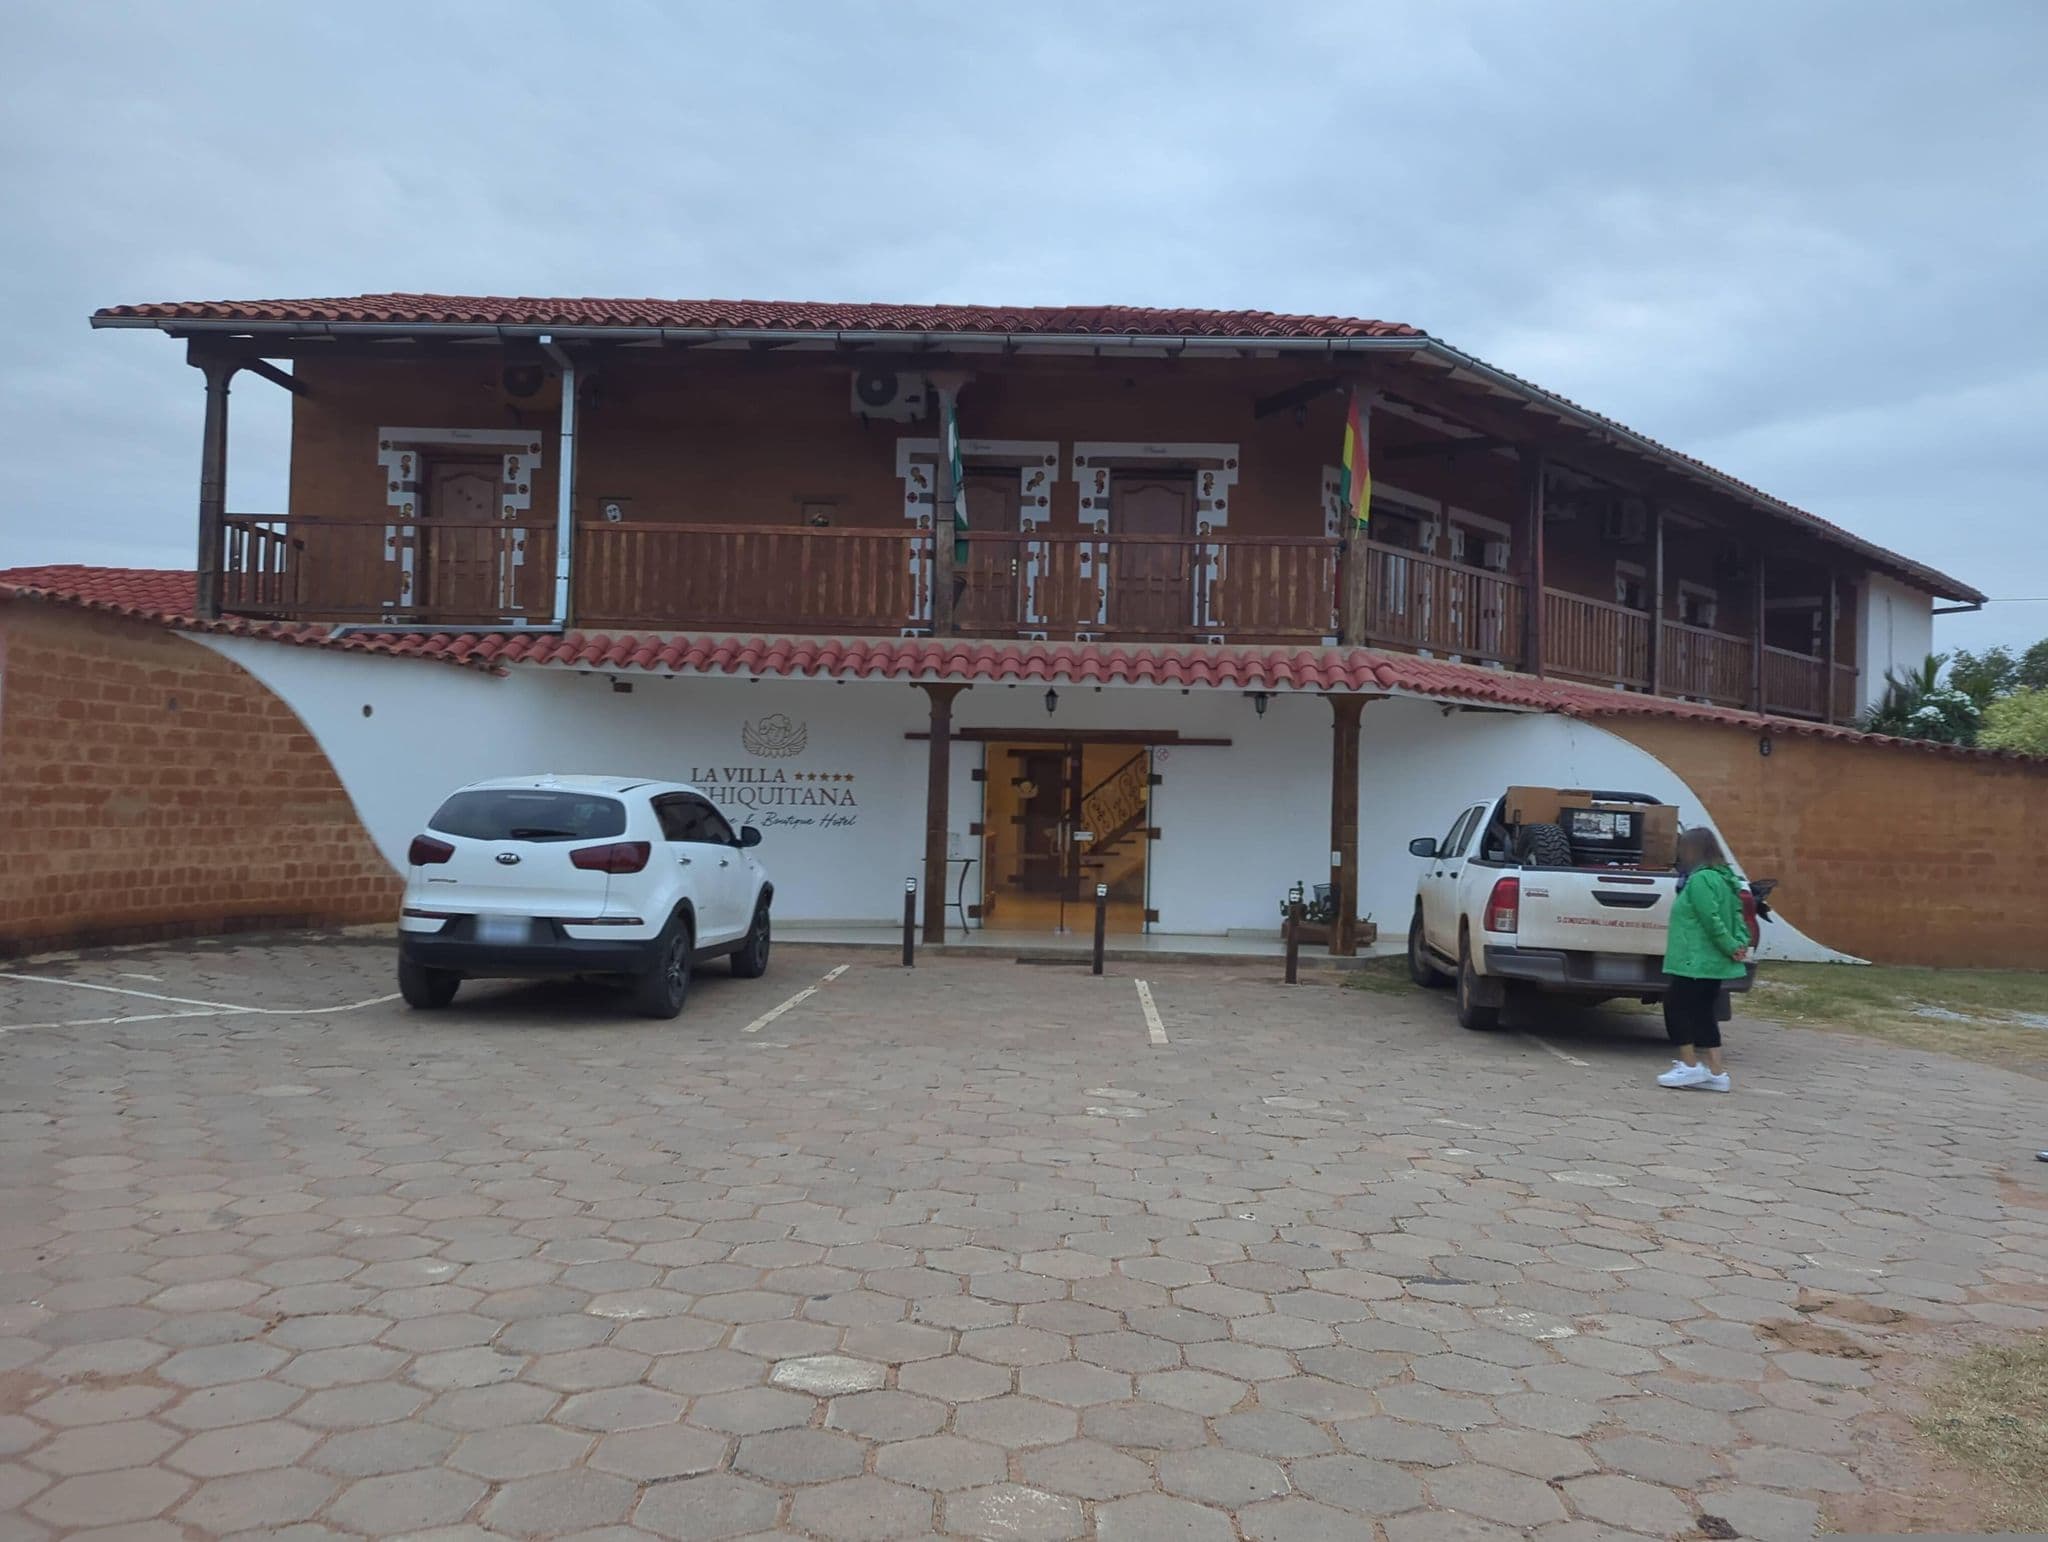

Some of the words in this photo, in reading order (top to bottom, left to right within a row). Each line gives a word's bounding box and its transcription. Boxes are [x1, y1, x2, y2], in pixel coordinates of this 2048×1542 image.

[691, 767, 717, 783] LA
[723, 767, 787, 784] VILLA
[761, 811, 815, 829] Boutique
[819, 812, 857, 828] Hotel
